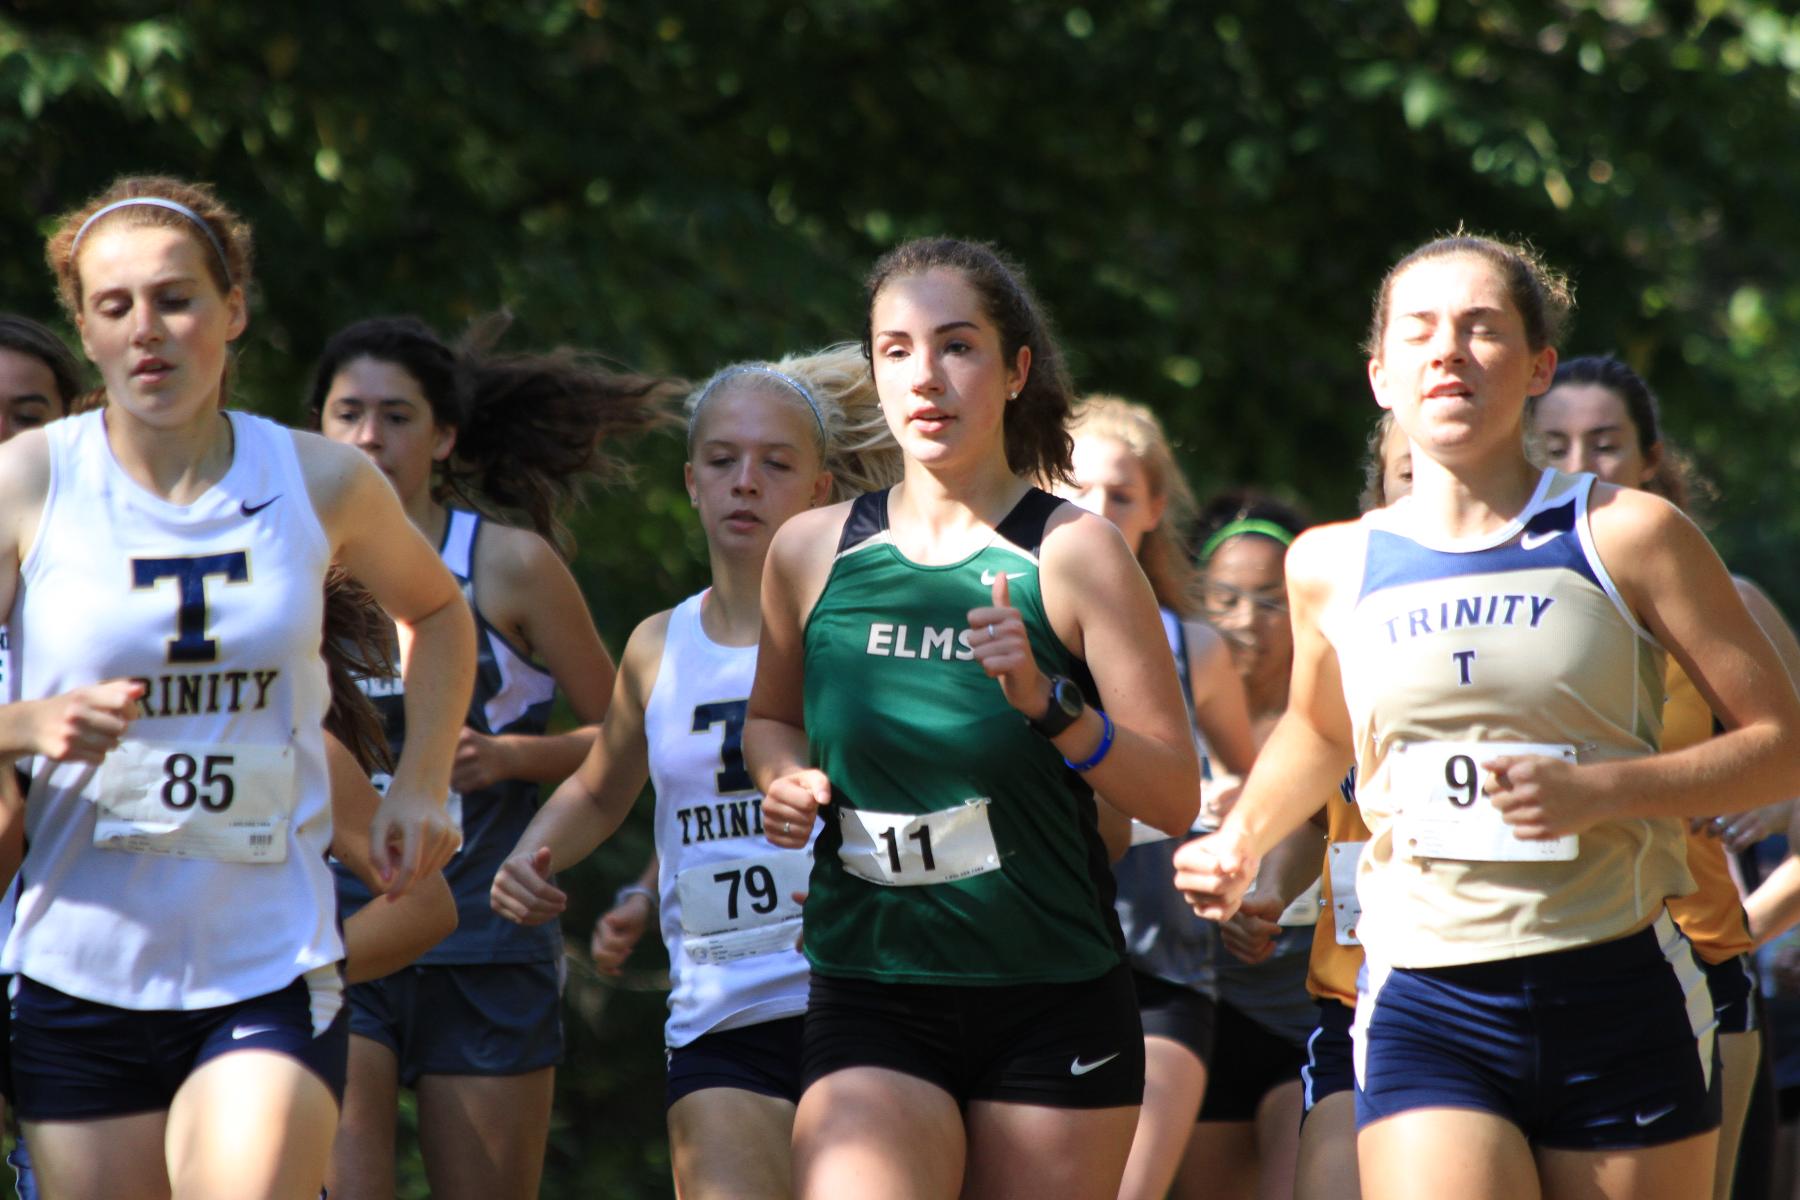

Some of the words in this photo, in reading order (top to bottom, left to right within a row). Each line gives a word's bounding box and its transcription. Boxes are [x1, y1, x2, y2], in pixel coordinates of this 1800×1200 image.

[130, 549, 252, 665] T
[1384, 594, 1556, 645] TRINITY
[866, 623, 976, 661] ELMS
[1452, 650, 1476, 685] T
[130, 667, 279, 718] RINITY
[160, 752, 235, 814] 85
[1444, 754, 1491, 810] 9
[677, 799, 765, 845] TRINI
[878, 824, 936, 873] 11
[713, 864, 778, 921] 79
